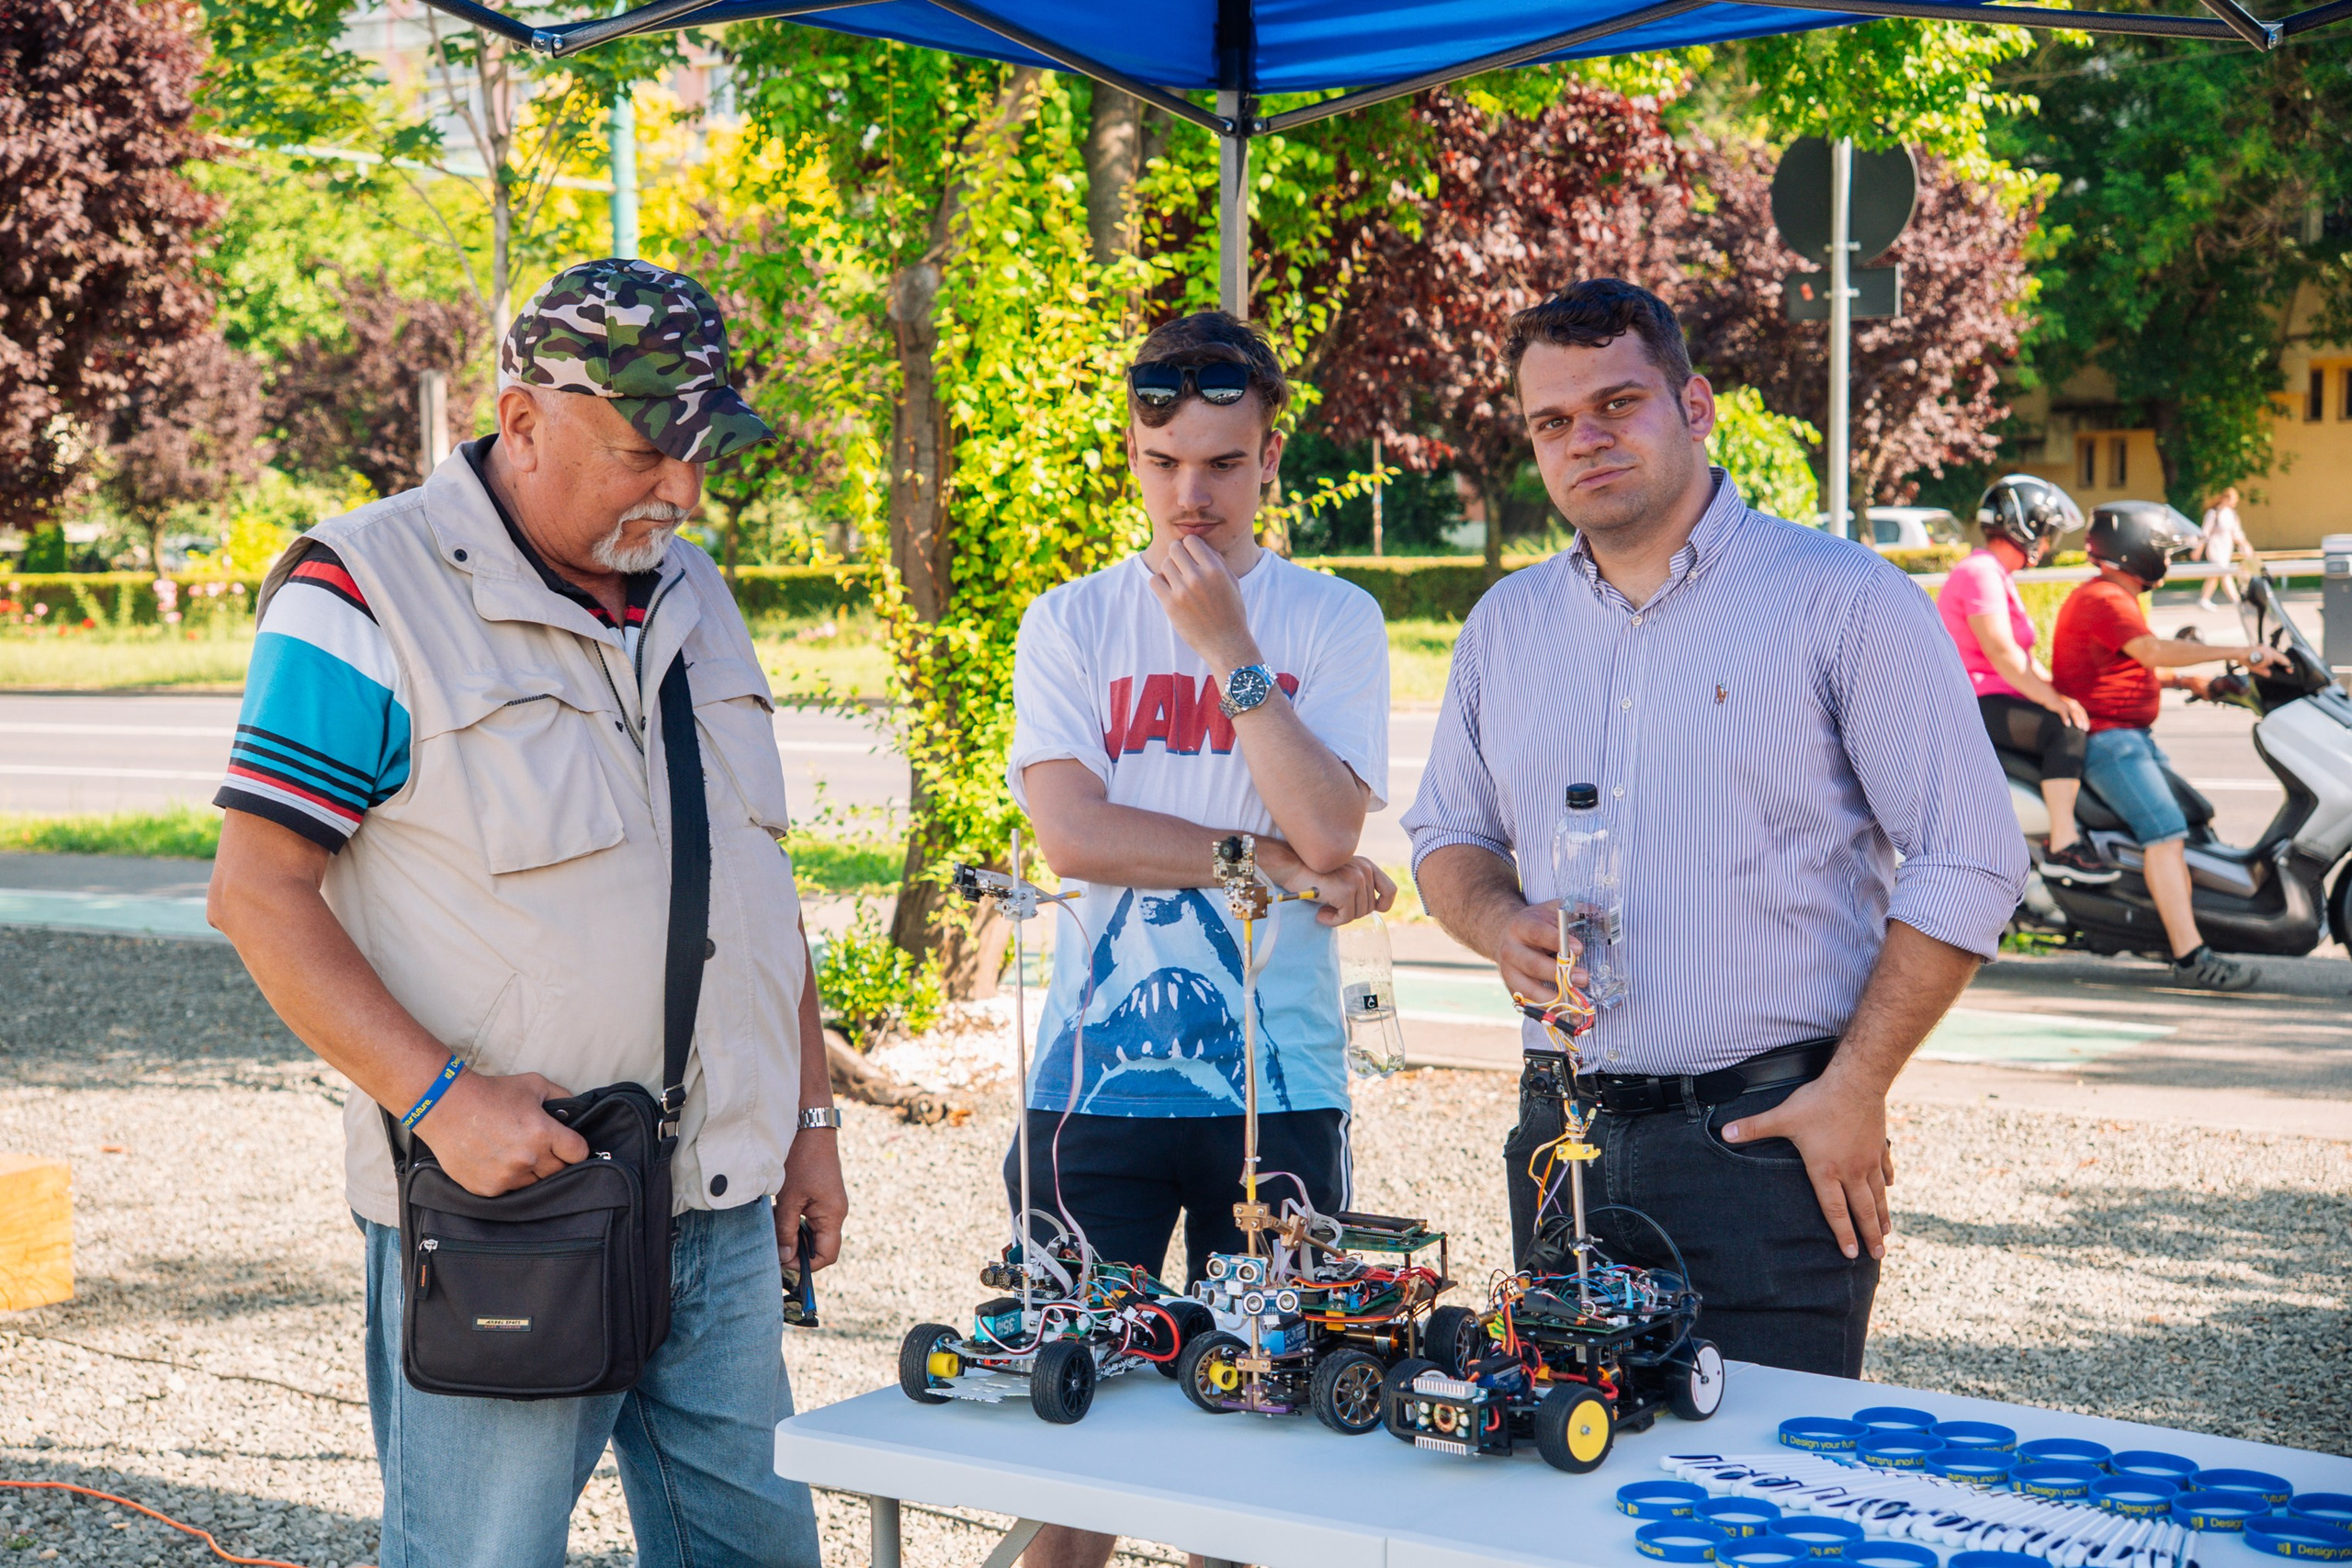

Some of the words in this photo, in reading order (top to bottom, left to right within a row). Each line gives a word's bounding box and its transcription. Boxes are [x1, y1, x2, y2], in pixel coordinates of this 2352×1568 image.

[1104, 672, 1300, 763] JAW
[1790, 1435, 1819, 1450] Design
[1820, 1440, 1840, 1450] your
[2025, 1483, 2061, 1498] Design
[2062, 1486, 2082, 1498] your
[2116, 1501, 2153, 1516] Design
[2298, 1543, 2337, 1560] Design
